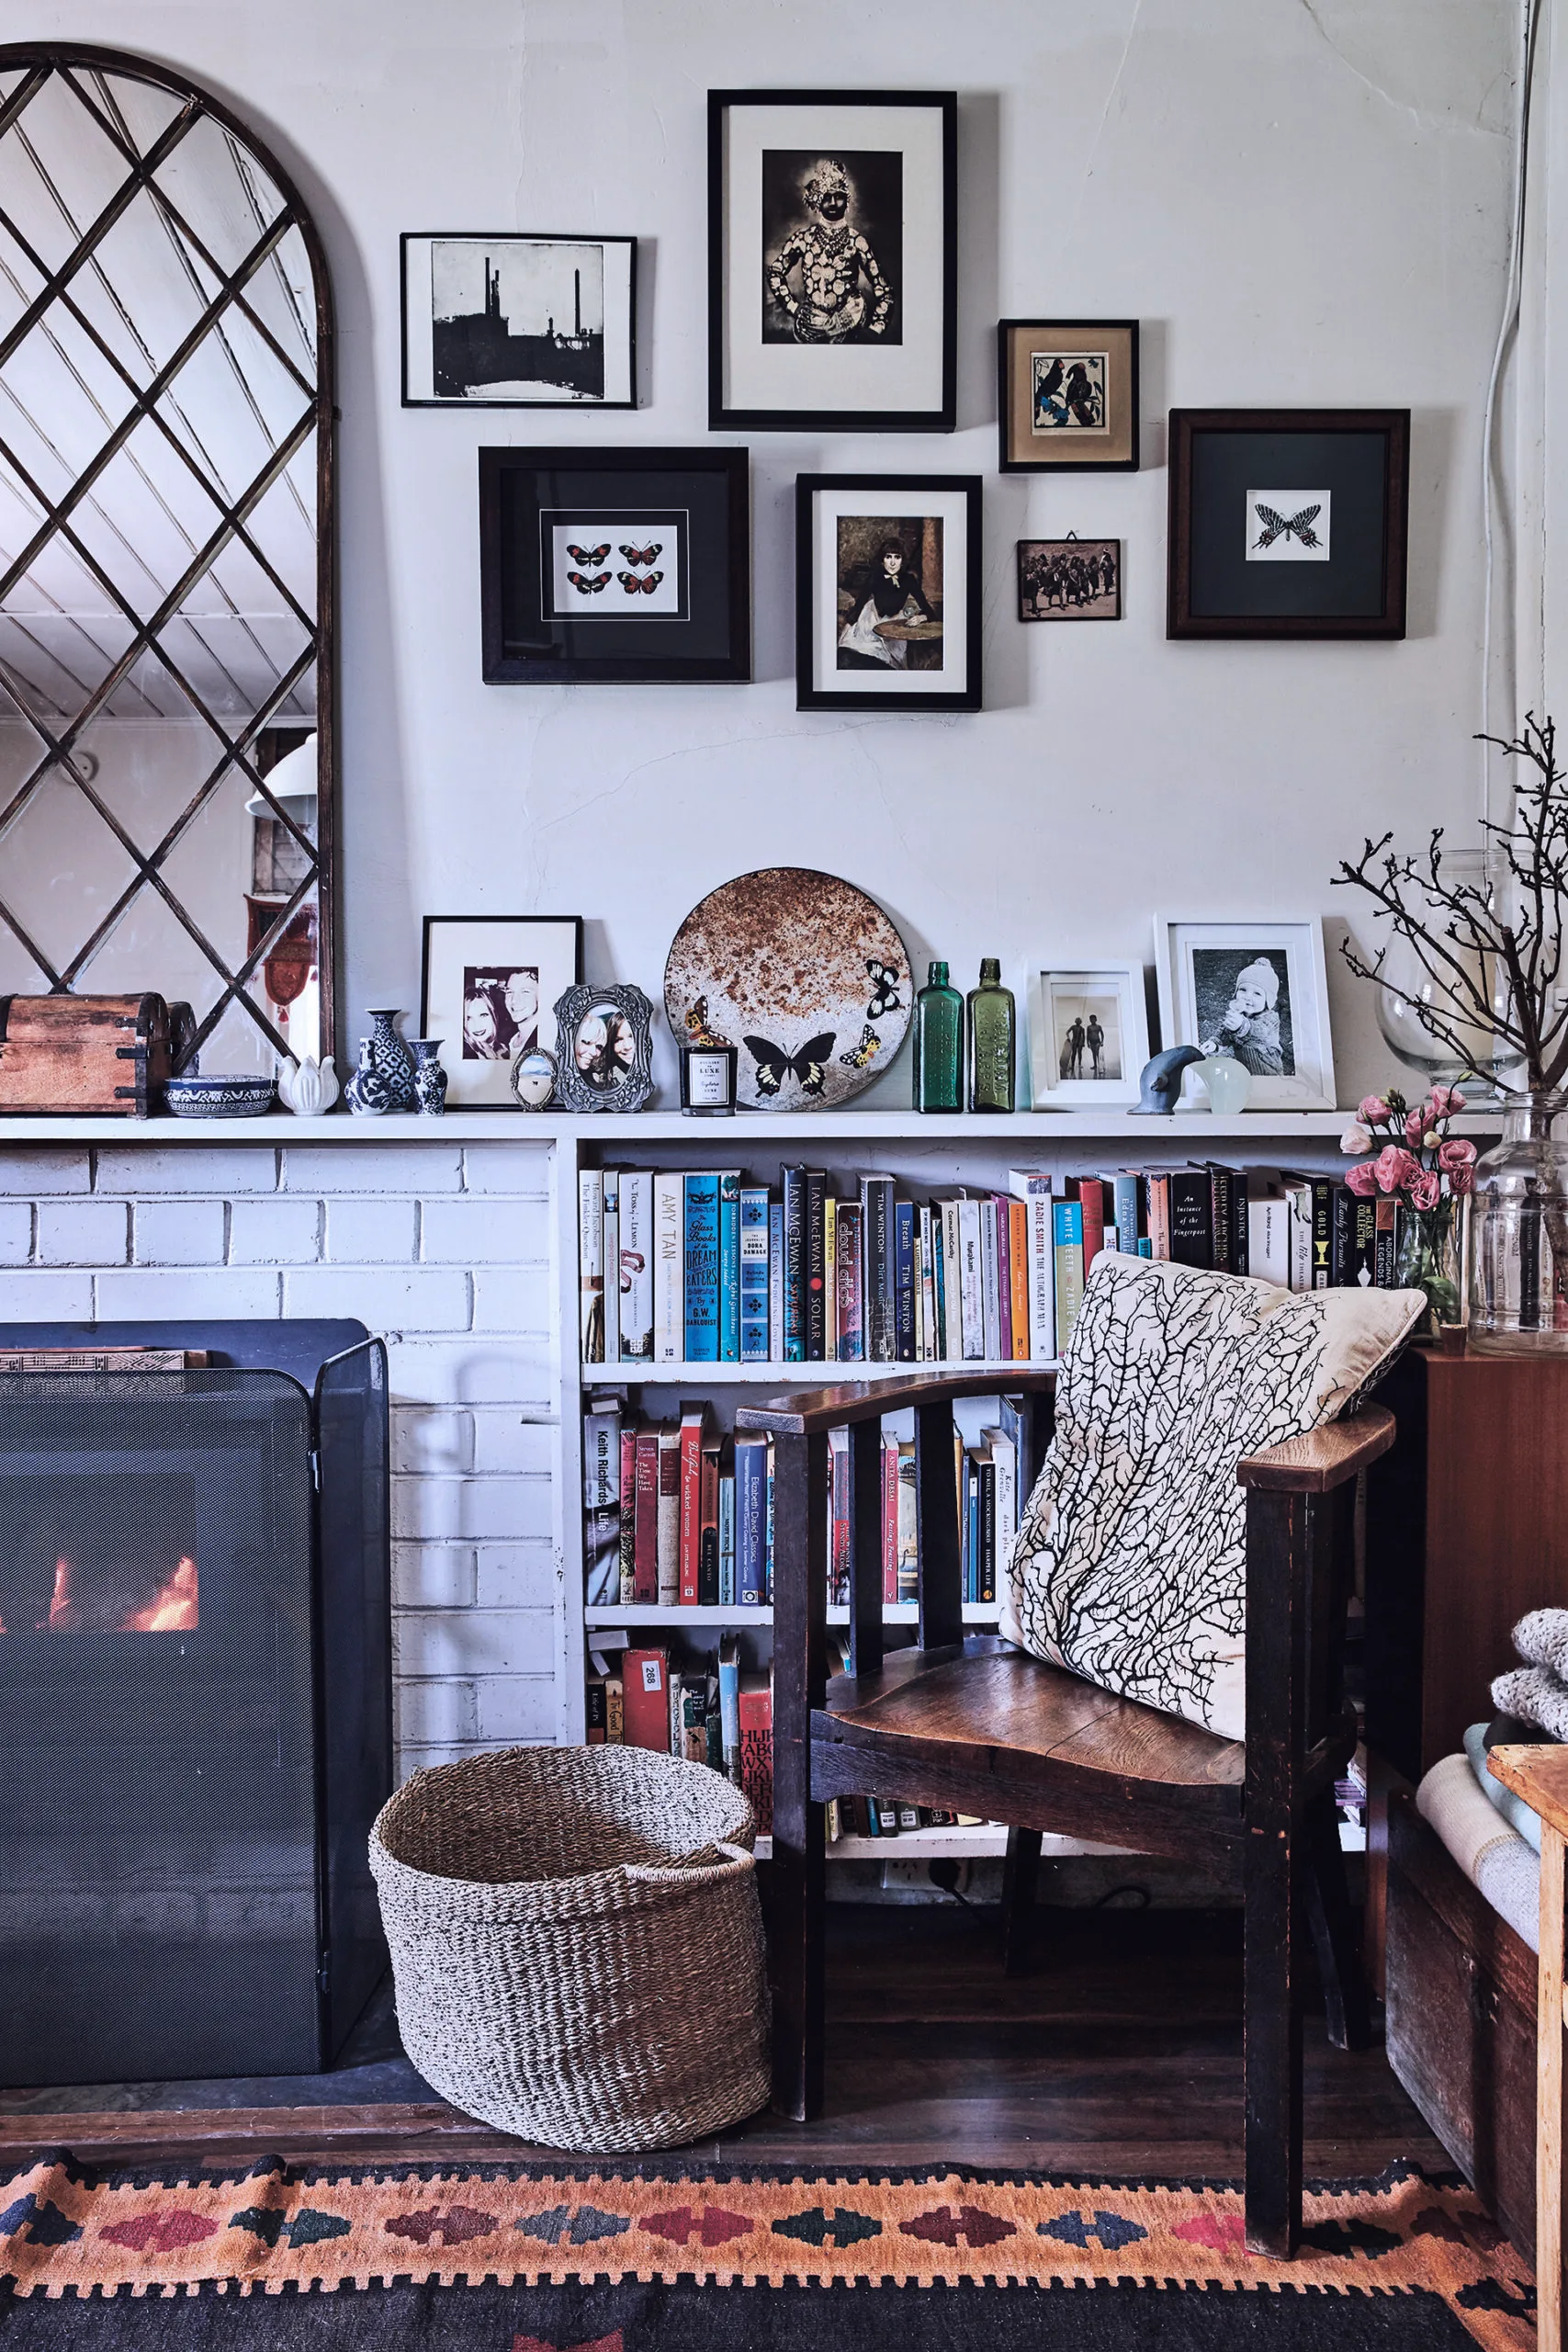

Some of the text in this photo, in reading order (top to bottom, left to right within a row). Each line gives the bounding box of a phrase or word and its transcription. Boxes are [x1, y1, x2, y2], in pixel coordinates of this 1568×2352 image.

[790, 1183, 801, 1207] IAN
[811, 1187, 820, 1211] IAN
[1035, 1202, 1043, 1225] ZADIE
[1122, 1198, 1130, 1222] Edna
[1213, 1176, 1229, 1260] JEFFREY ARCHER
[1236, 1197, 1246, 1240] INJUSTICE
[1317, 1210, 1326, 1236] GOLD
[592, 1215, 600, 1248] Jacobson
[661, 1193, 676, 1260] AMY TAN
[686, 1231, 716, 1242] Books
[689, 1220, 714, 1231] Glass
[1335, 1198, 1348, 1268] Manly Pursuits
[1356, 1204, 1365, 1249] COLLECTOR
[1365, 1215, 1373, 1238] GLASS
[581, 1227, 590, 1259] Question
[1064, 1207, 1074, 1272] WHITE TEETH
[686, 1250, 716, 1270] DREAM
[839, 1222, 853, 1308] cloud atlas
[1036, 1257, 1044, 1270] THE
[686, 1268, 716, 1286] EATERS
[902, 1220, 911, 1332] Breath TIM WINTON
[693, 1308, 710, 1317] G.W.
[696, 1296, 705, 1305] By
[791, 1283, 799, 1335] SATURDAY
[1066, 1287, 1075, 1316] ZADIE
[811, 1297, 821, 1340] SOLAR
[598, 1430, 609, 1531] Keith Richards Life
[986, 1468, 991, 1476] TO
[751, 1476, 760, 1509] Elizabeth
[750, 1534, 759, 1563] Classics
[646, 1667, 656, 1684] 268
[609, 1711, 622, 1730] Good
